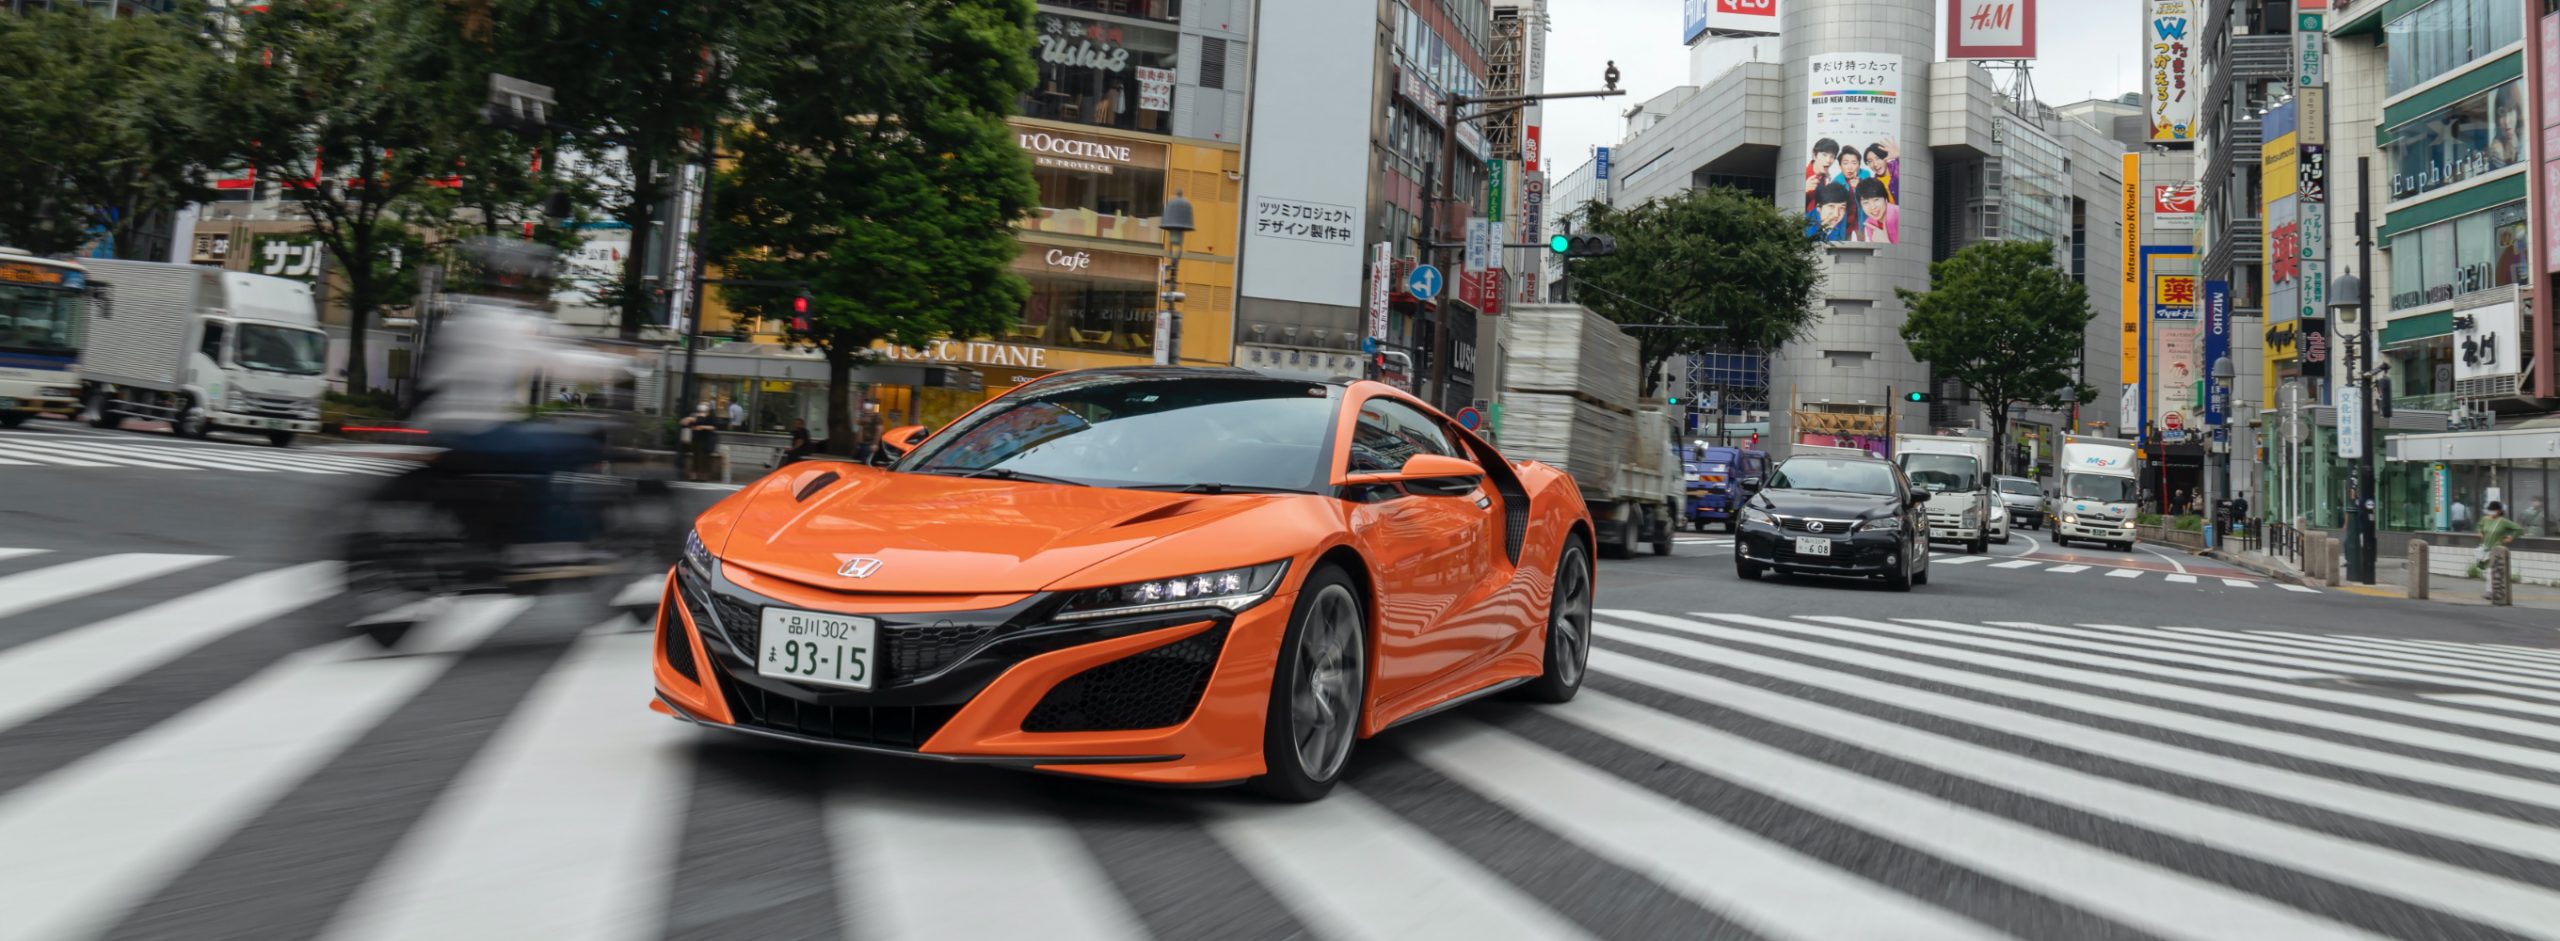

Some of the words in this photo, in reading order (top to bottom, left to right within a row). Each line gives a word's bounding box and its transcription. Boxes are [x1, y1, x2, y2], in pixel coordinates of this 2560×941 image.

[1970, 4, 2014, 30] H&M
[1039, 34, 1129, 72] Ushi8
[1813, 60, 1898, 73] 夢だけ持ったって
[2154, 43, 2171, 115] つかえる!
[1142, 83, 1169, 95] テイク
[1824, 75, 1884, 86] いいでしょ?
[1142, 96, 1169, 108] アウト
[1812, 97, 1828, 105] HELLO
[1830, 95, 1843, 104] NEW
[1870, 96, 1896, 104] PROJECT
[1020, 133, 1131, 161] L'OCCITANE
[2301, 163, 2311, 181] バー
[2393, 148, 2484, 196] Euphoria
[1260, 202, 1352, 223] ツツミプロジェクト
[2126, 184, 2136, 222] KiYoshi
[1258, 219, 1351, 241] デザイン製作中
[2314, 213, 2322, 243] フルーツ
[1046, 249, 1090, 271] Café
[2126, 223, 2136, 283] Matsumoto
[1485, 270, 1496, 299] アコム
[2164, 278, 2193, 303] 薬
[2213, 292, 2223, 335] MIZUHO
[788, 616, 849, 640] 品川302
[768, 646, 777, 663] ま
[784, 639, 867, 682] 93-15
